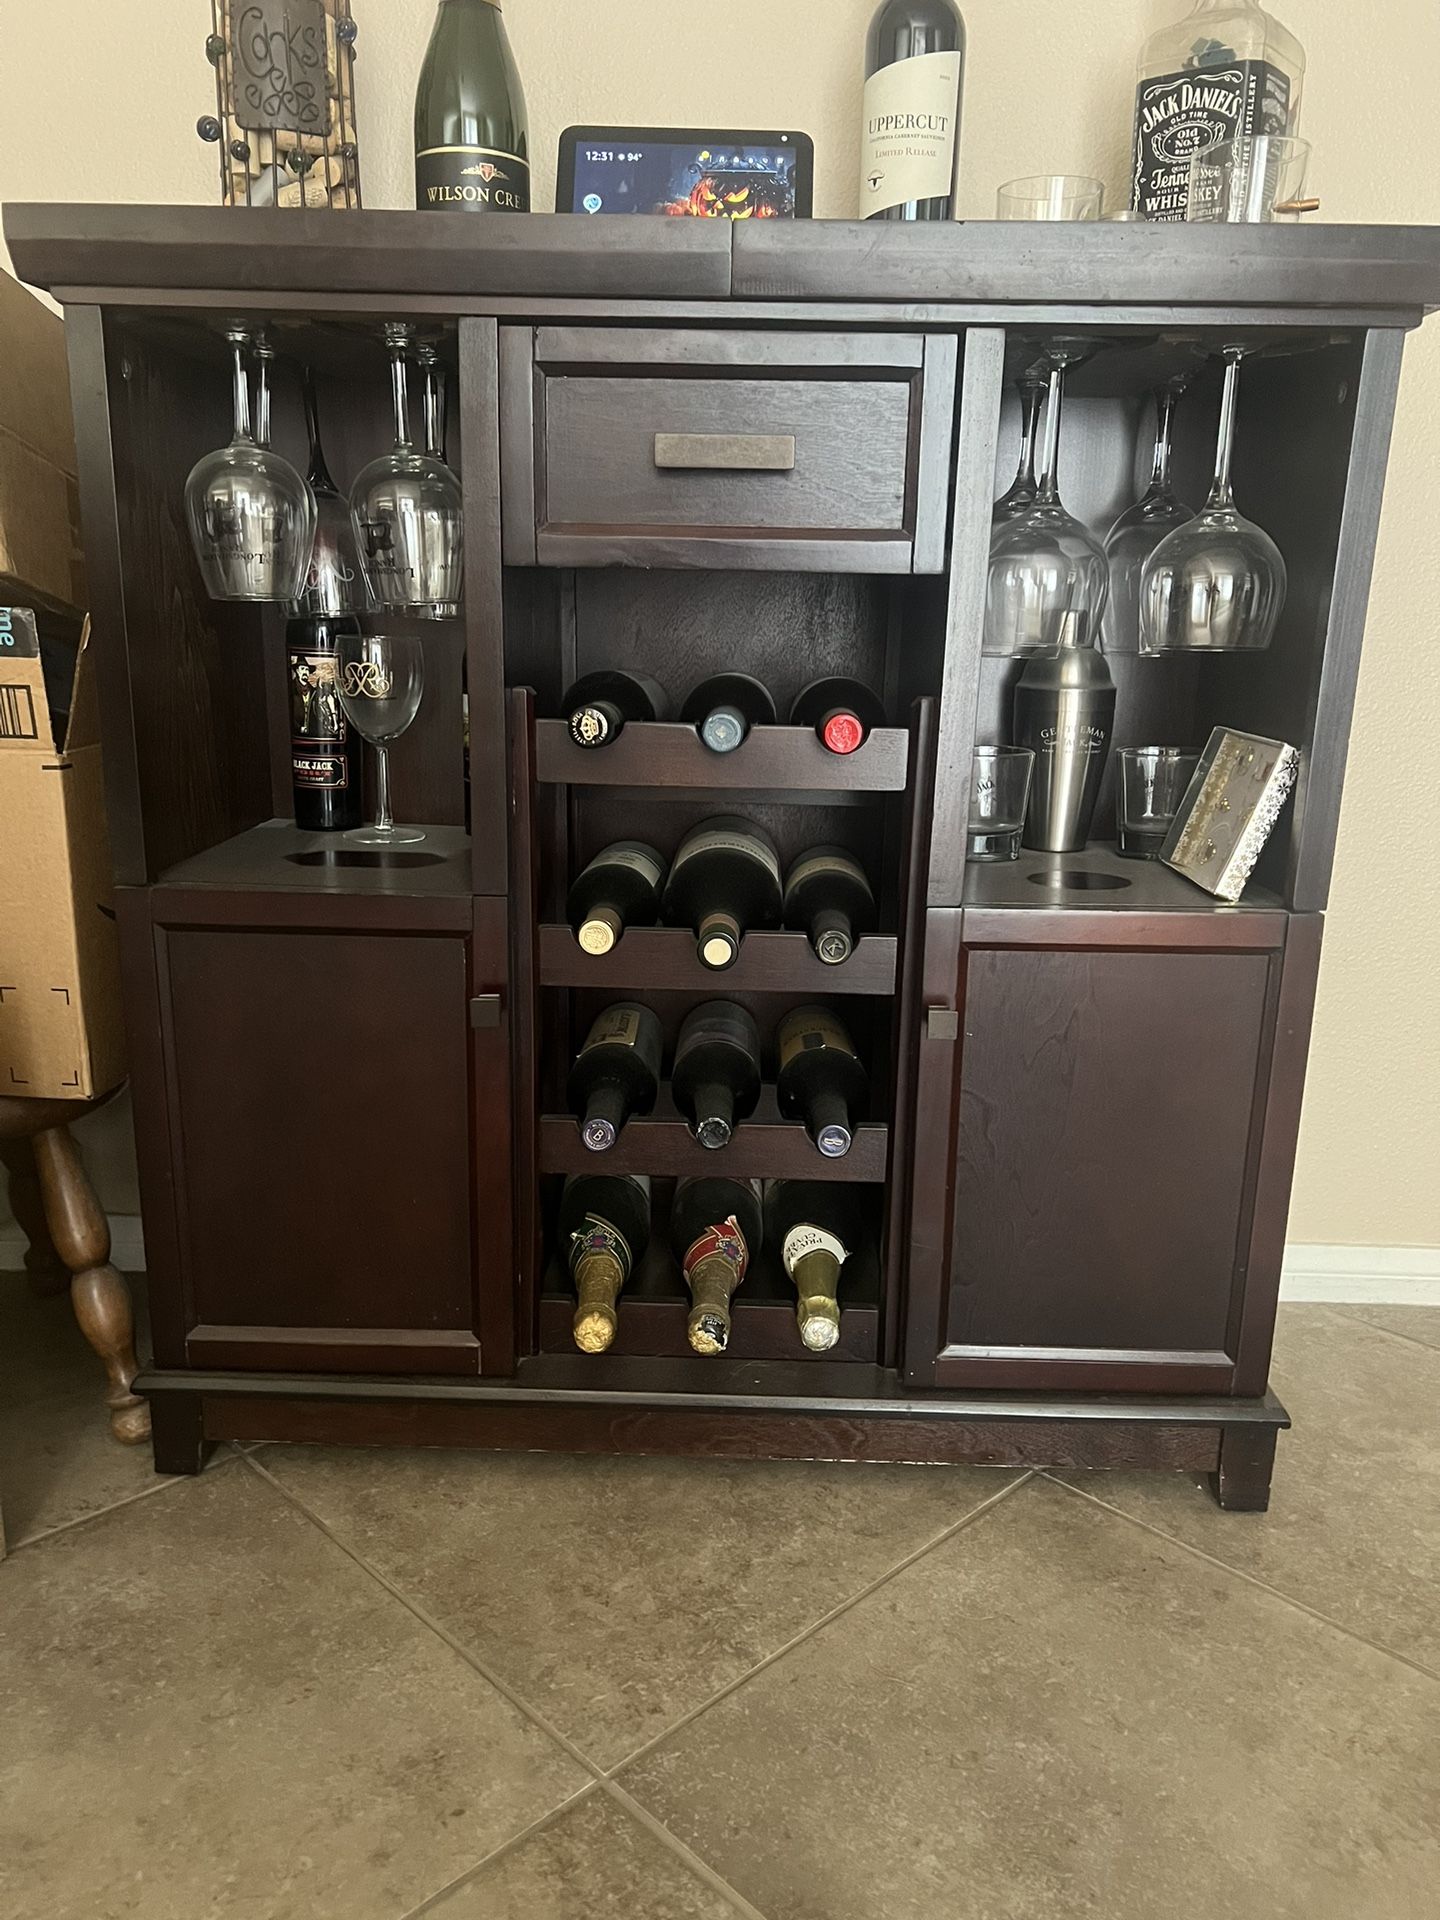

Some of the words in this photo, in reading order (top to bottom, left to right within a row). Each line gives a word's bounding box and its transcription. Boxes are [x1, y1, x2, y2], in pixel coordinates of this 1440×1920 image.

[1142, 93, 1181, 133] JACK
[1181, 84, 1243, 118] DANIEL'S
[868, 114, 949, 134] UPPERCUT
[1170, 113, 1187, 124] OLD
[1189, 111, 1208, 119] TIME
[1177, 127, 1199, 140] Old
[1174, 136, 1201, 149] No.7
[585, 151, 614, 161] 12:31
[627, 153, 643, 162] 94°
[1174, 146, 1200, 155] BRAND
[427, 186, 490, 202] WILSON
[495, 189, 524, 209] CRE
[1040, 725, 1106, 740] GETEMAN
[311, 761, 334, 771] JACK
